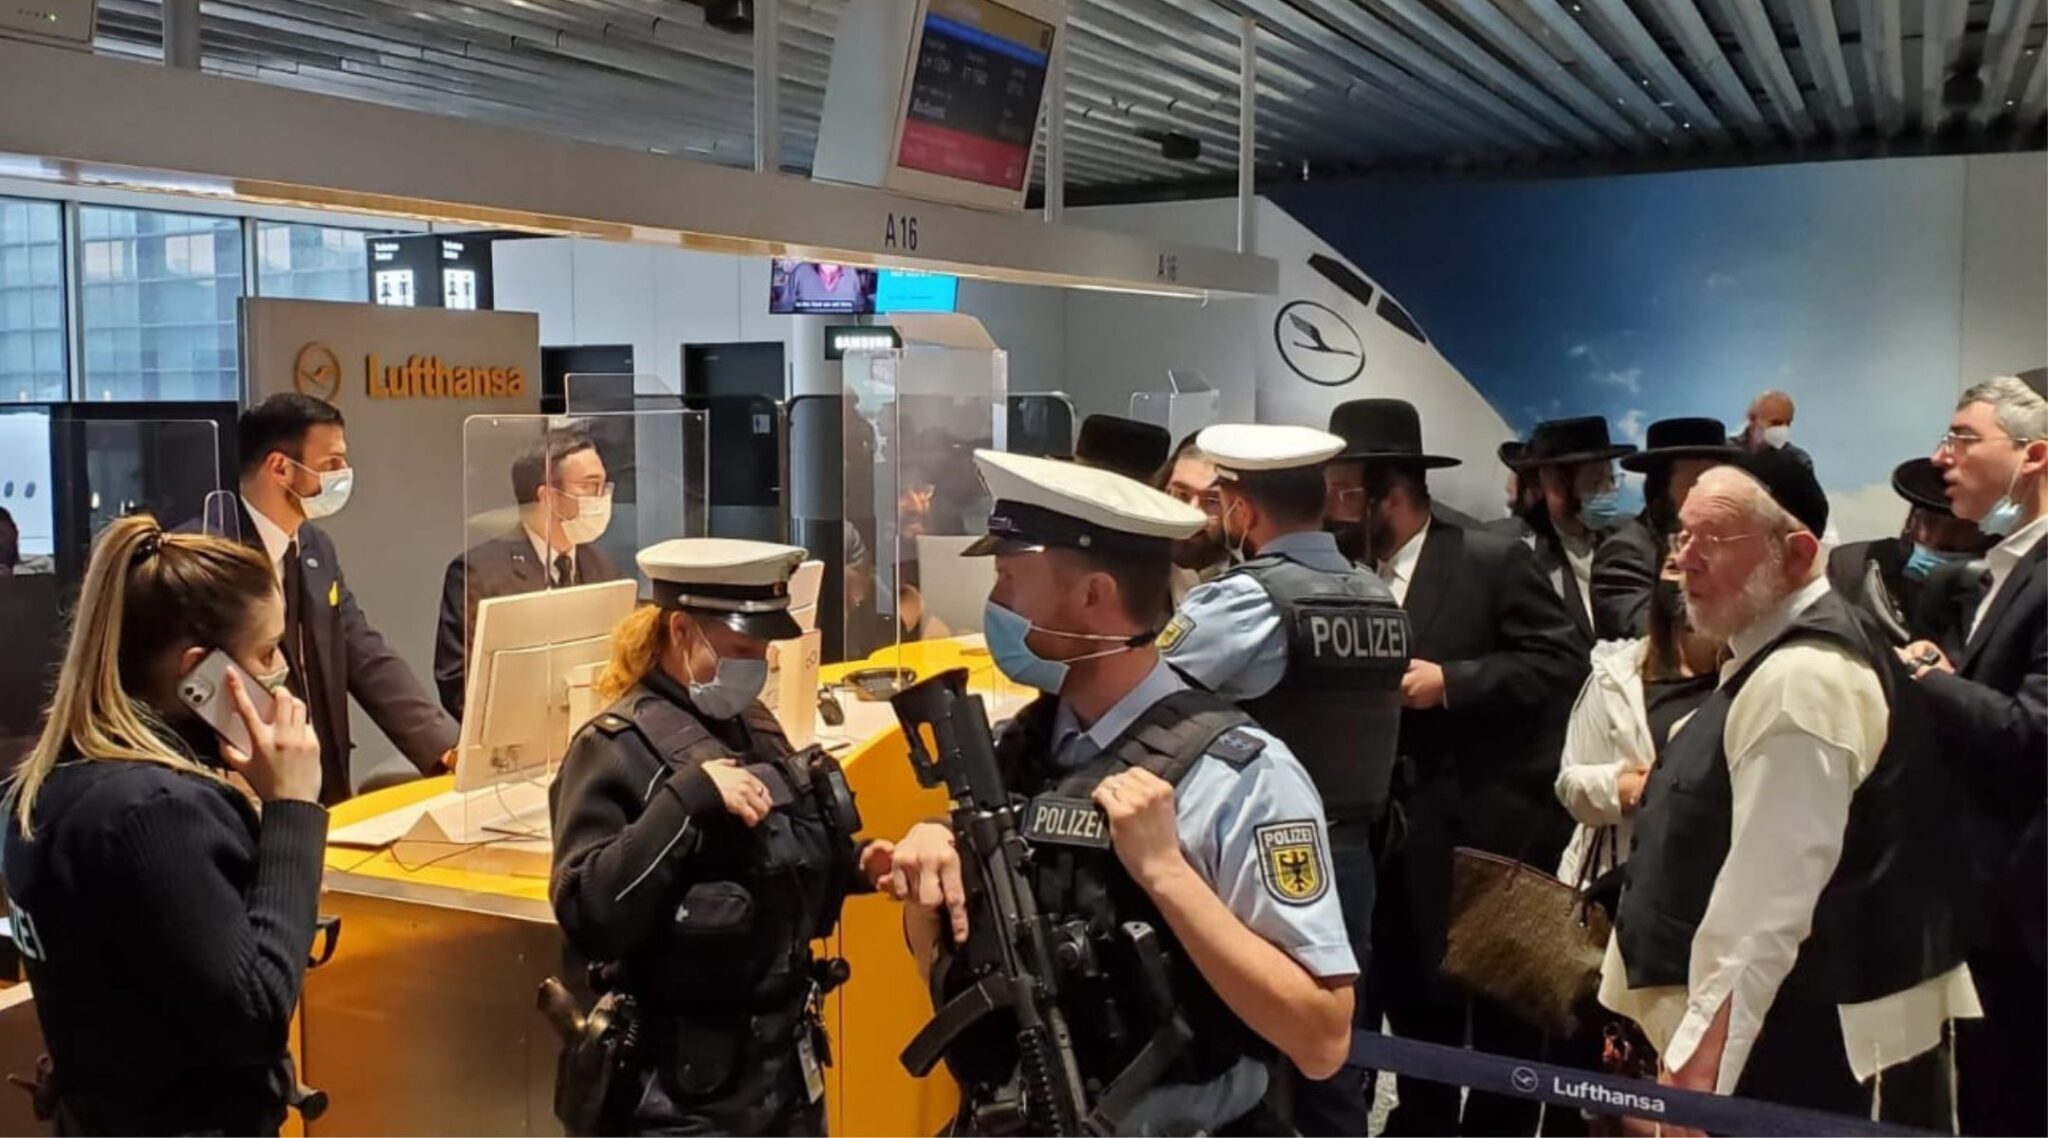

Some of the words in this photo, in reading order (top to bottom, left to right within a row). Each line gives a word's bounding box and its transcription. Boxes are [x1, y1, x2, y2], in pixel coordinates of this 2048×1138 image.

[885, 211, 897, 248] A
[900, 215, 916, 251] 16
[366, 352, 527, 400] Lufthansa
[1310, 615, 1407, 658] POLIZEI
[1033, 805, 1104, 839] POLIZEI
[1264, 827, 1312, 848] POLIZEI
[1552, 1075, 1666, 1113] Lufthansa
